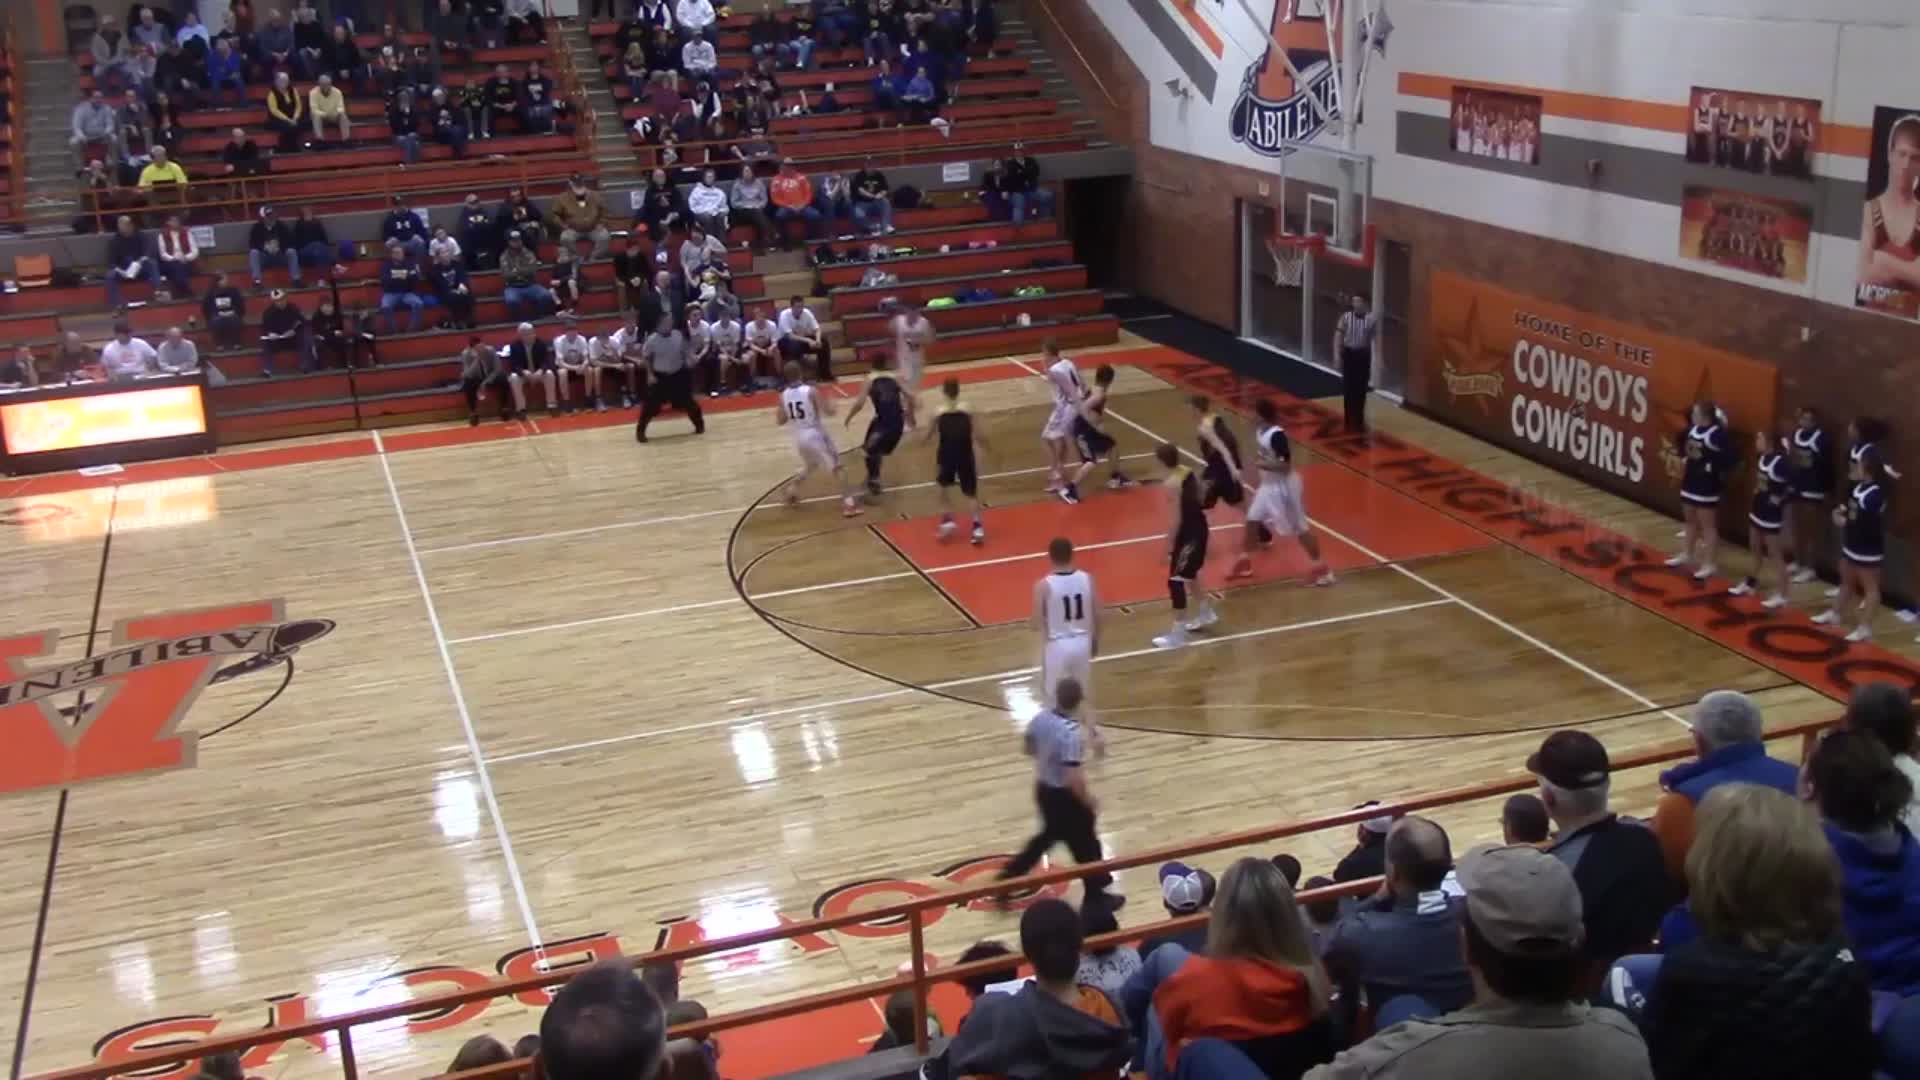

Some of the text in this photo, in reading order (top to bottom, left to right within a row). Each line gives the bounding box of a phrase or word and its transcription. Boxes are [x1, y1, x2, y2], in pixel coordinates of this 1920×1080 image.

[1514, 310, 1652, 366] HOME OF THE
[788, 401, 805, 420] 15
[1513, 339, 1648, 423] COWBOYS
[1511, 393, 1644, 483] COWGIRLS
[1062, 593, 1084, 621] 11
[1557, 538, 1920, 693] SCHOO
[0, 629, 262, 706] ABILEN
